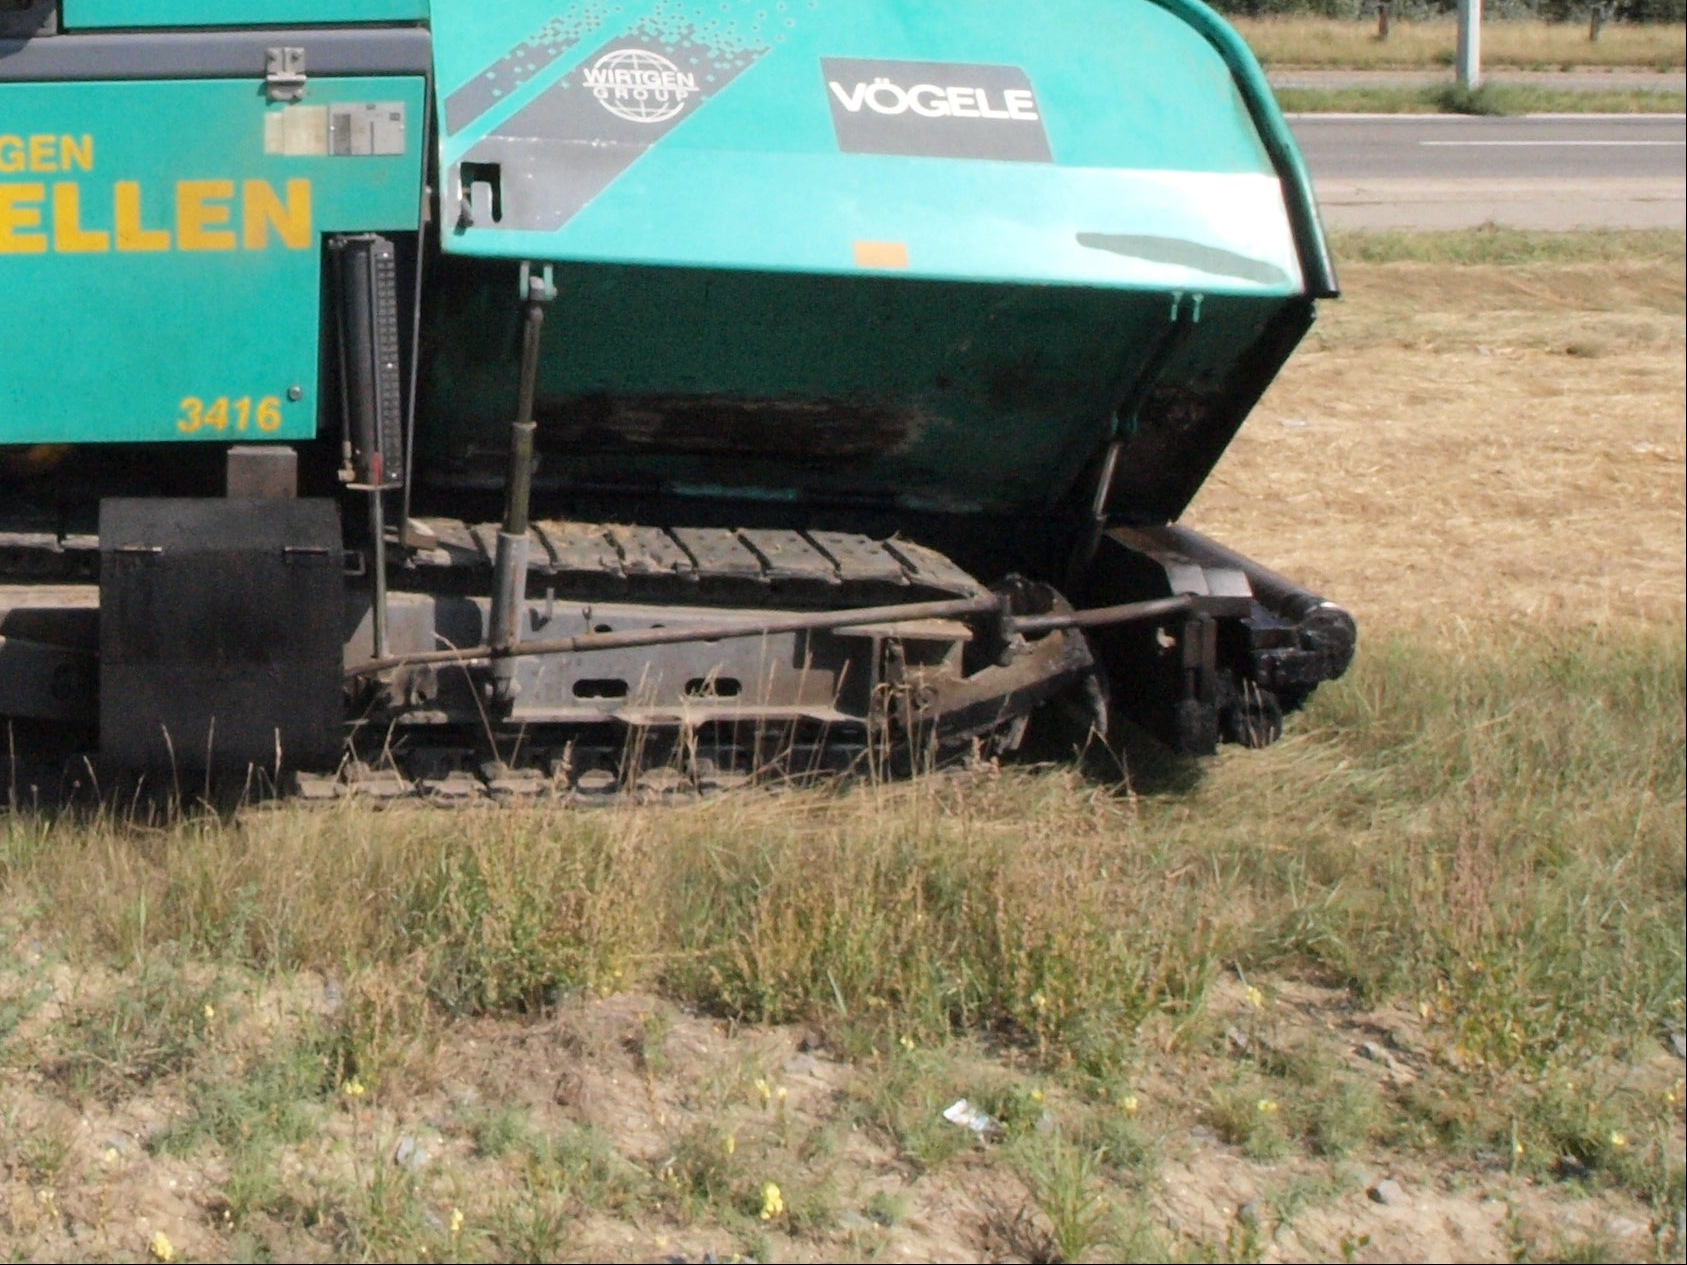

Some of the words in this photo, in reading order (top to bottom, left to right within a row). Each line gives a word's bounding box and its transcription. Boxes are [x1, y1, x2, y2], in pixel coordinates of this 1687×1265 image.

[583, 67, 696, 87] WIRTGEN
[592, 86, 689, 102] GROUP
[828, 77, 1039, 121] VÖGELE
[178, 396, 282, 433] 3416
